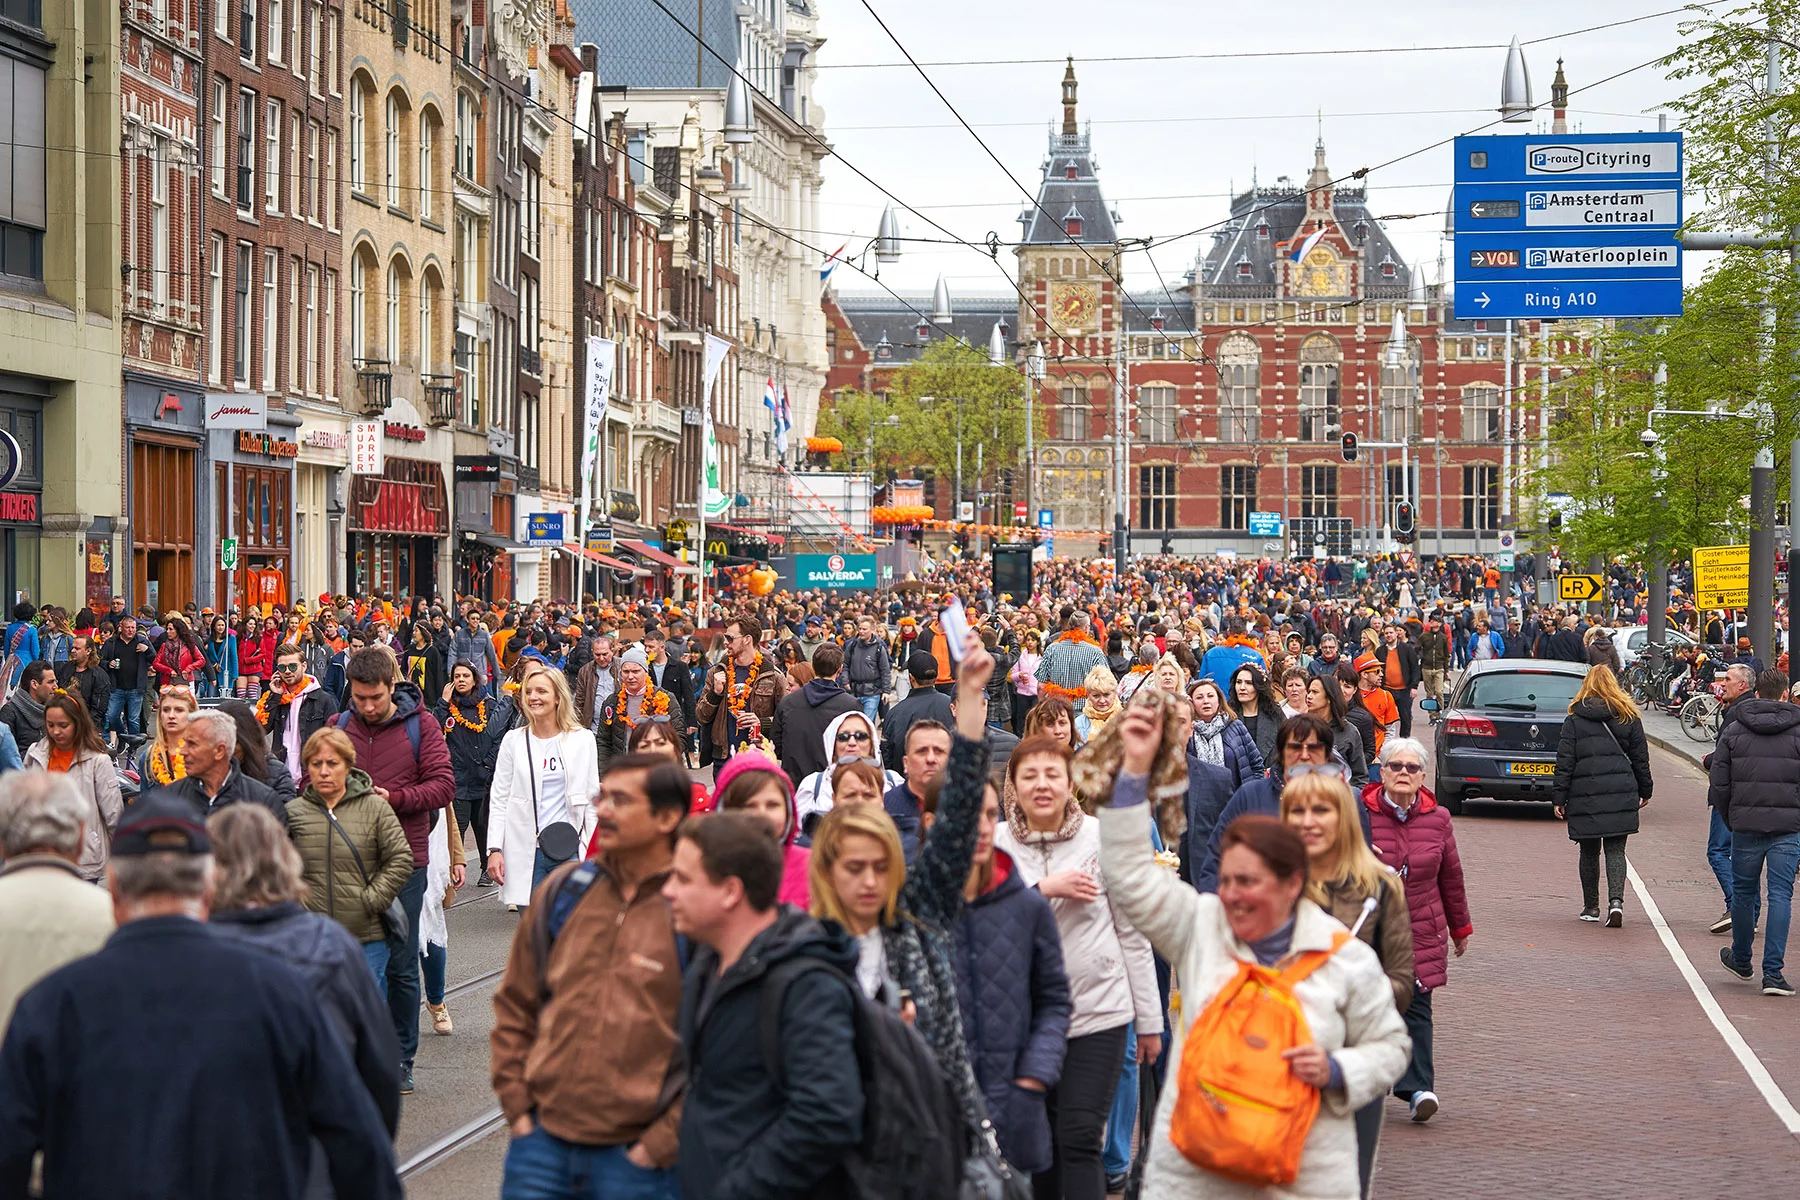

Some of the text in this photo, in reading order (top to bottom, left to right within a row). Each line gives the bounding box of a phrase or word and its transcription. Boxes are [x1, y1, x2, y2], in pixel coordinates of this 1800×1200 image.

[1586, 151, 1651, 168] Cityring
[1550, 192, 1644, 206] Amsterdam
[1584, 209, 1654, 223] Centraal
[1486, 251, 1518, 266] VOL
[1550, 248, 1668, 264] Waterlooplein
[1525, 292, 1597, 309] Ring A10
[211, 404, 259, 420] jamin
[240, 429, 264, 454] Holland
[367, 424, 376, 472] MARKT
[1, 493, 37, 521] TICKETS
[808, 571, 865, 580] SALVERDA
[1703, 566, 1741, 574] Ruijterkade
[1572, 581, 1584, 594] R
